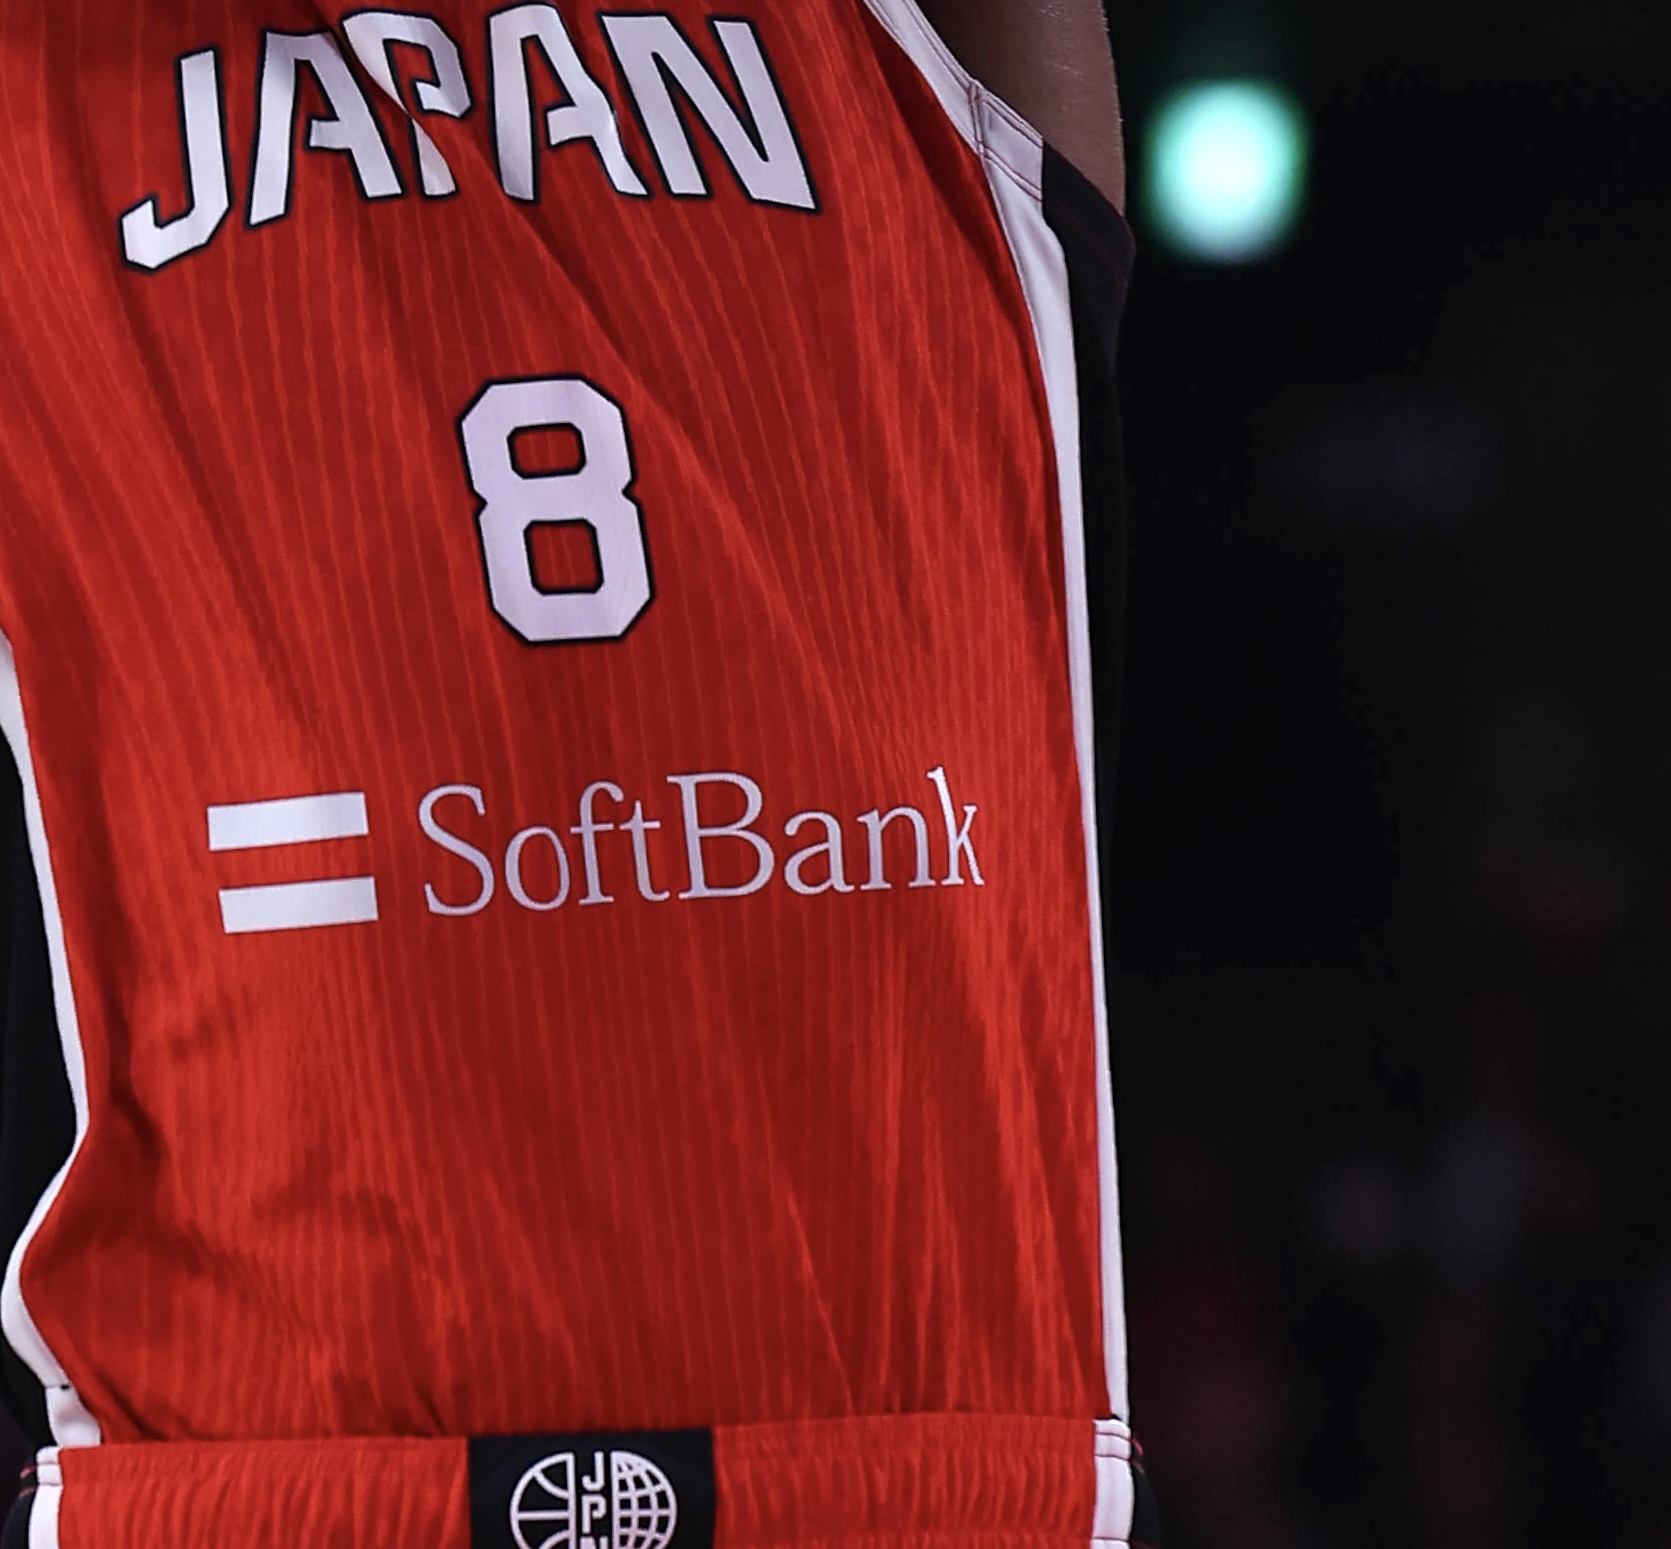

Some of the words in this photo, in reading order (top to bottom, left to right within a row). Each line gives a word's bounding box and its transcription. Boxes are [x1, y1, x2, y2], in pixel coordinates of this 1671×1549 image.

[119, 2, 818, 271] JAPAN
[458, 377, 653, 644] 8
[419, 767, 984, 916] SoftBank
